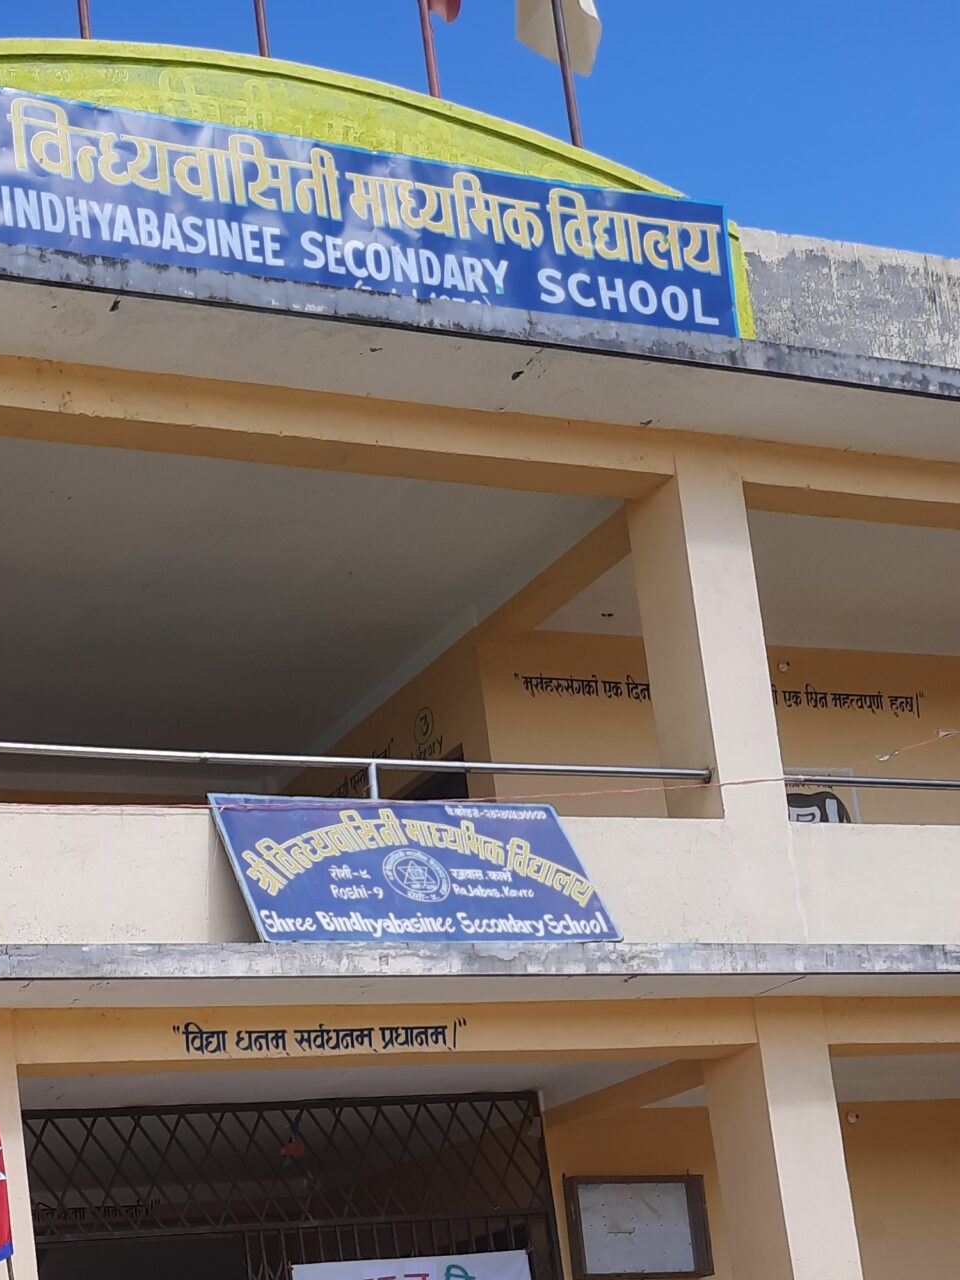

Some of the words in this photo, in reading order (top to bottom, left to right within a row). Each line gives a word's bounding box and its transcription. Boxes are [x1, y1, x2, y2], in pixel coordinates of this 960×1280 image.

[345, 172, 542, 250] माध्यमिक
[547, 188, 722, 276] विद्यालय
[300, 230, 508, 294] SECONDARY
[537, 269, 719, 326] SCHOOL
[601, 680, 623, 698] एक
[625, 675, 651, 702] दिन
[782, 690, 801, 708] एक
[242, 850, 288, 896] श्री
[401, 818, 505, 866] माध्यमिक
[506, 837, 597, 908] विद्यालय
[260, 909, 316, 933] Shree
[315, 911, 455, 937] Bindhyabasinee
[456, 912, 544, 937] Secondary
[543, 911, 608, 934] School
[235, 1029, 290, 1056] धनम्
